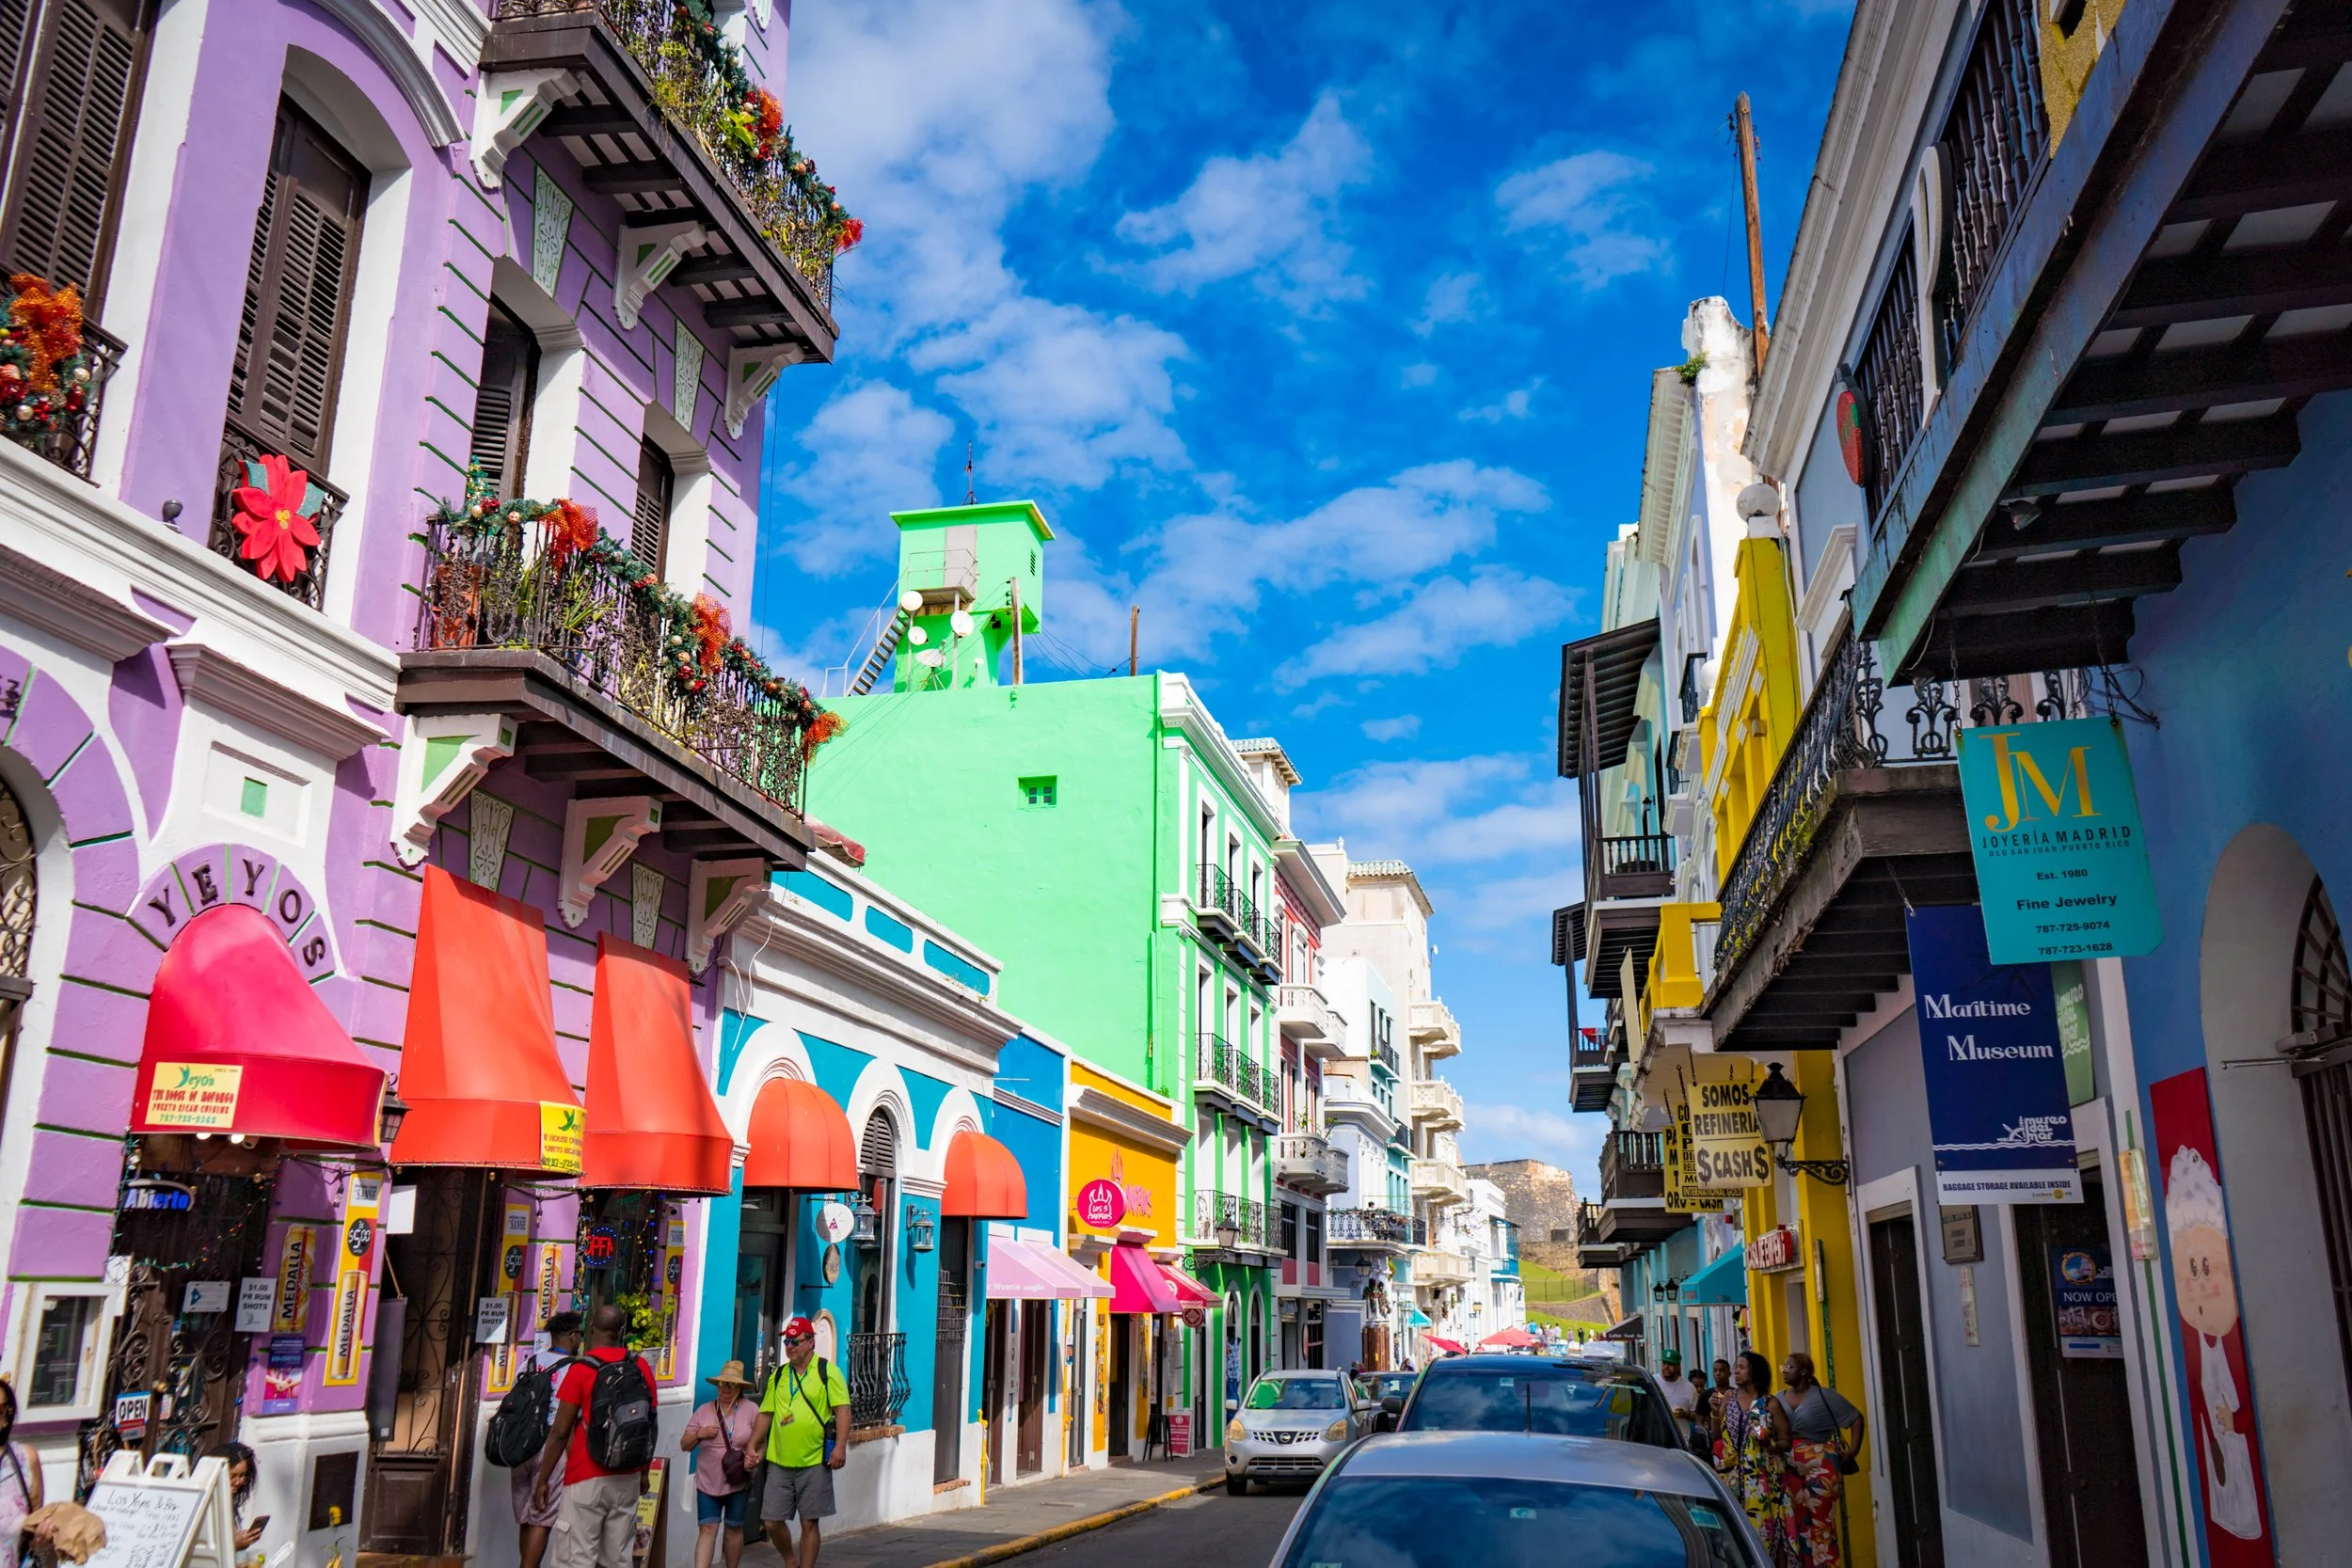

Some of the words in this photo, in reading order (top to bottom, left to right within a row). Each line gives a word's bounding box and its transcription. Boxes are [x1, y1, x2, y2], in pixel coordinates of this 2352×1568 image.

[1978, 732, 2103, 832] JM
[1982, 830, 2049, 848] JOYERÍA
[2056, 826, 2131, 844] MADRID
[2062, 843, 2101, 851] PUERTO
[2106, 840, 2130, 848] RICO
[2036, 871, 2058, 880] Est.
[2060, 868, 2089, 879] 1980
[148, 858, 326, 967] YEYOS
[2016, 898, 2050, 911] Fine
[2055, 894, 2118, 908] Jewelry
[2036, 921, 2110, 933] 787-725-9074
[2038, 942, 2113, 956] 787-723-1628
[1923, 994, 2031, 1019] Maritime
[1947, 1035, 2054, 1061] Museum
[1701, 1084, 1750, 1108] SOMOS
[1943, 1182, 1976, 1192] BAGGAGE
[1977, 1181, 2009, 1191] STORAGE
[2010, 1180, 2046, 1190] AVAILABLE
[2047, 1180, 2072, 1189] INSIDE
[124, 1188, 189, 1211] Abierto
[282, 1241, 302, 1320] MEDALLA
[541, 1256, 553, 1320] MEDALLA
[243, 1302, 268, 1310] SHOTS
[2063, 1291, 2092, 1303] NOW
[2095, 1291, 2118, 1303] OPE
[339, 1290, 355, 1357] MEDALLA
[119, 1399, 148, 1419] OPEN
